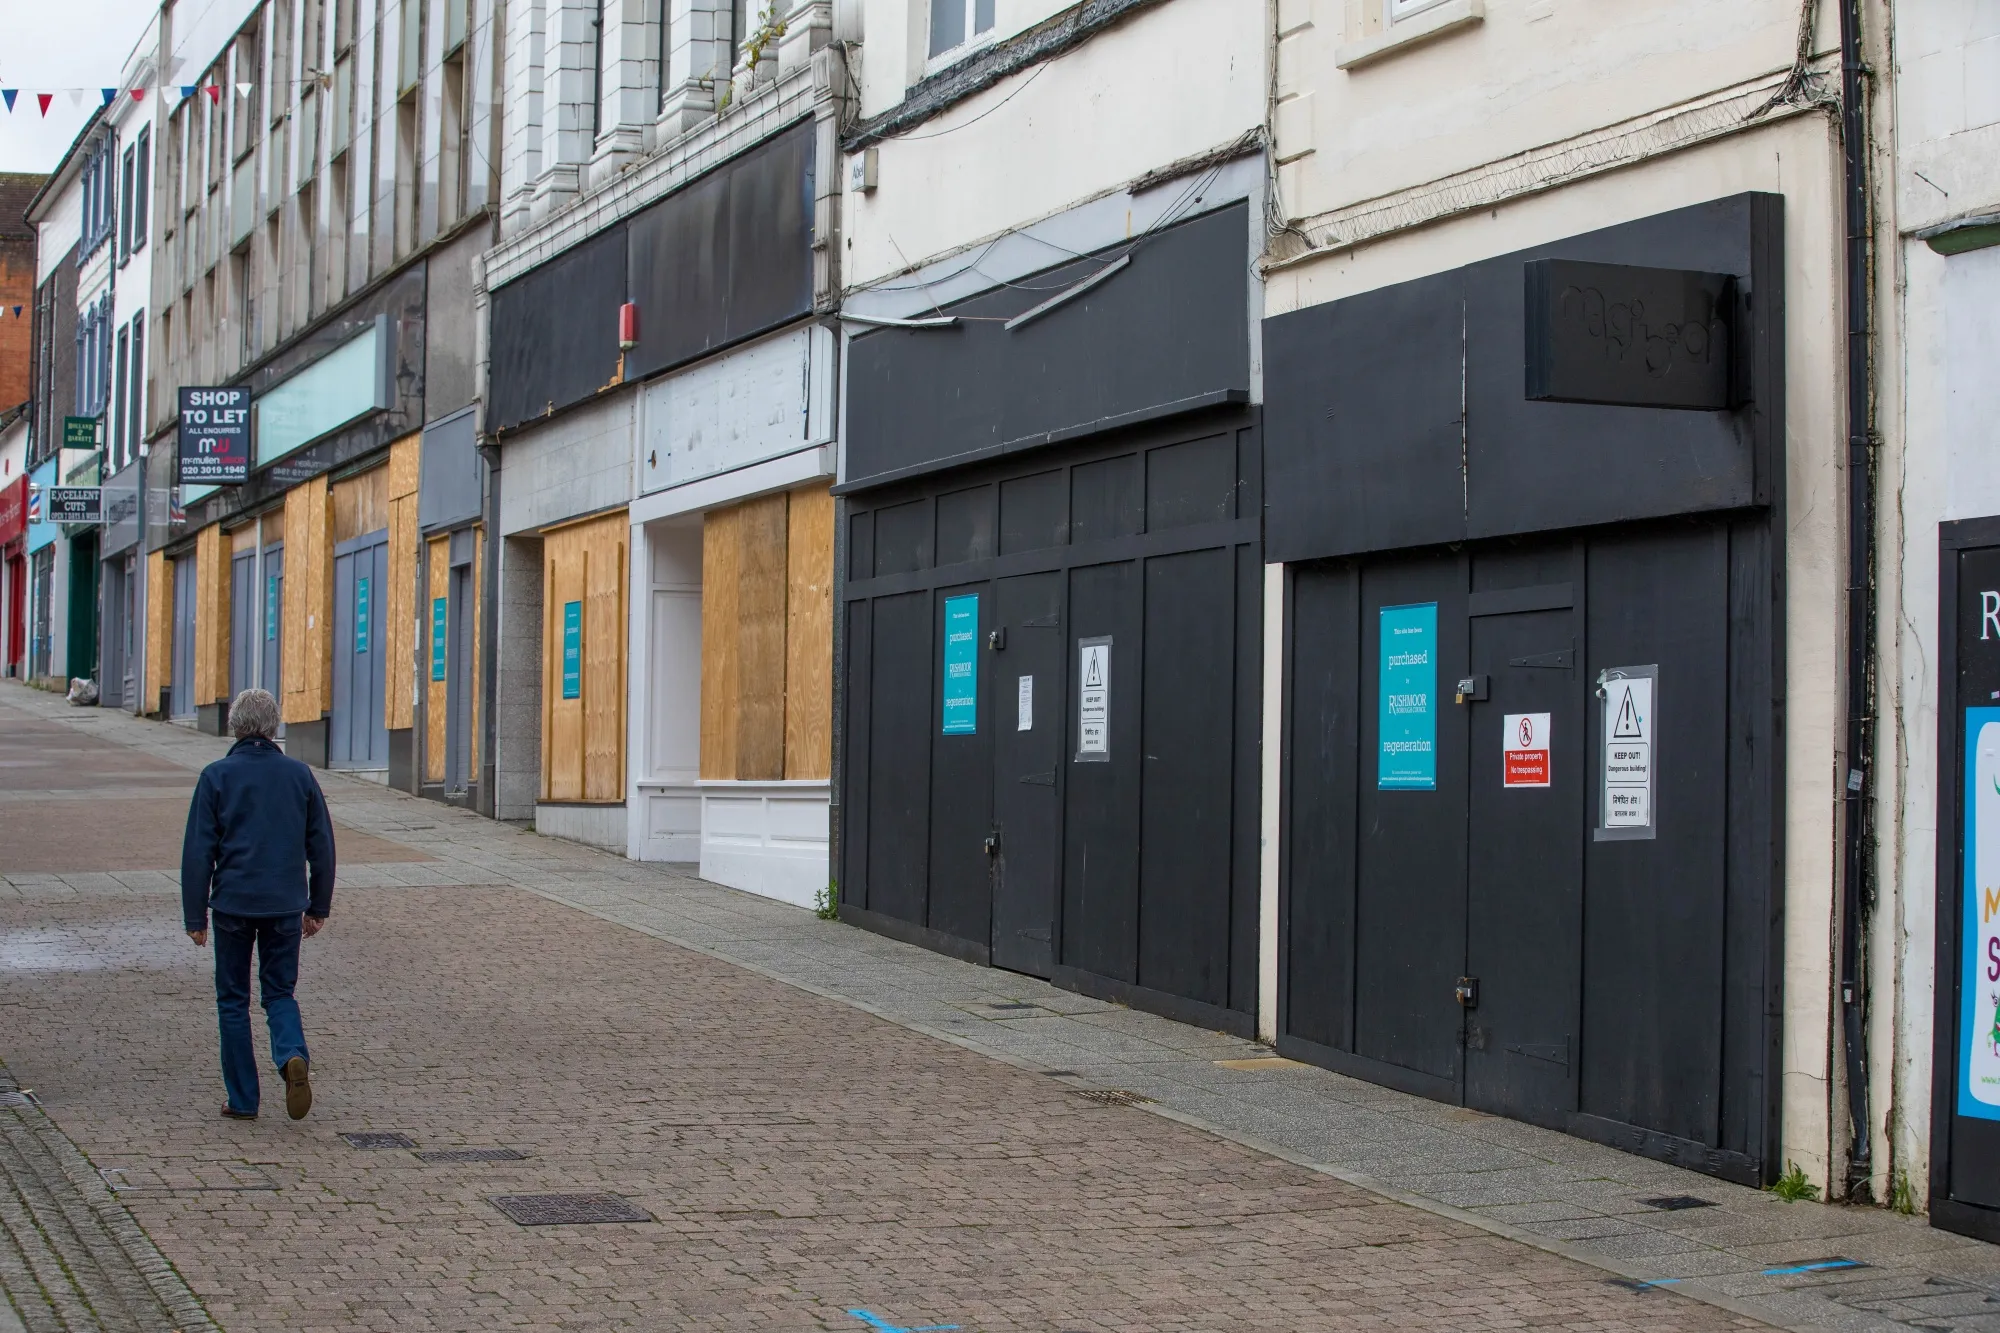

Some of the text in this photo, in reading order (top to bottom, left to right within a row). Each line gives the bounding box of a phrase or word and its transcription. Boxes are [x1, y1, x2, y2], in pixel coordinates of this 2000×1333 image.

[190, 391, 241, 406] SHOP
[183, 410, 247, 424] TO LET
[201, 466, 222, 474] 3019
[51, 490, 100, 502] EXCELLENT
[64, 502, 86, 511] CUTS
[1388, 649, 1428, 670] purchased
[1388, 694, 1426, 715] RUSHMOOR
[1383, 738, 1431, 755] regeneration
[1524, 752, 1543, 761] property
[1517, 766, 1543, 775] trespassing
[1608, 765, 1646, 773] Dangerous building!
